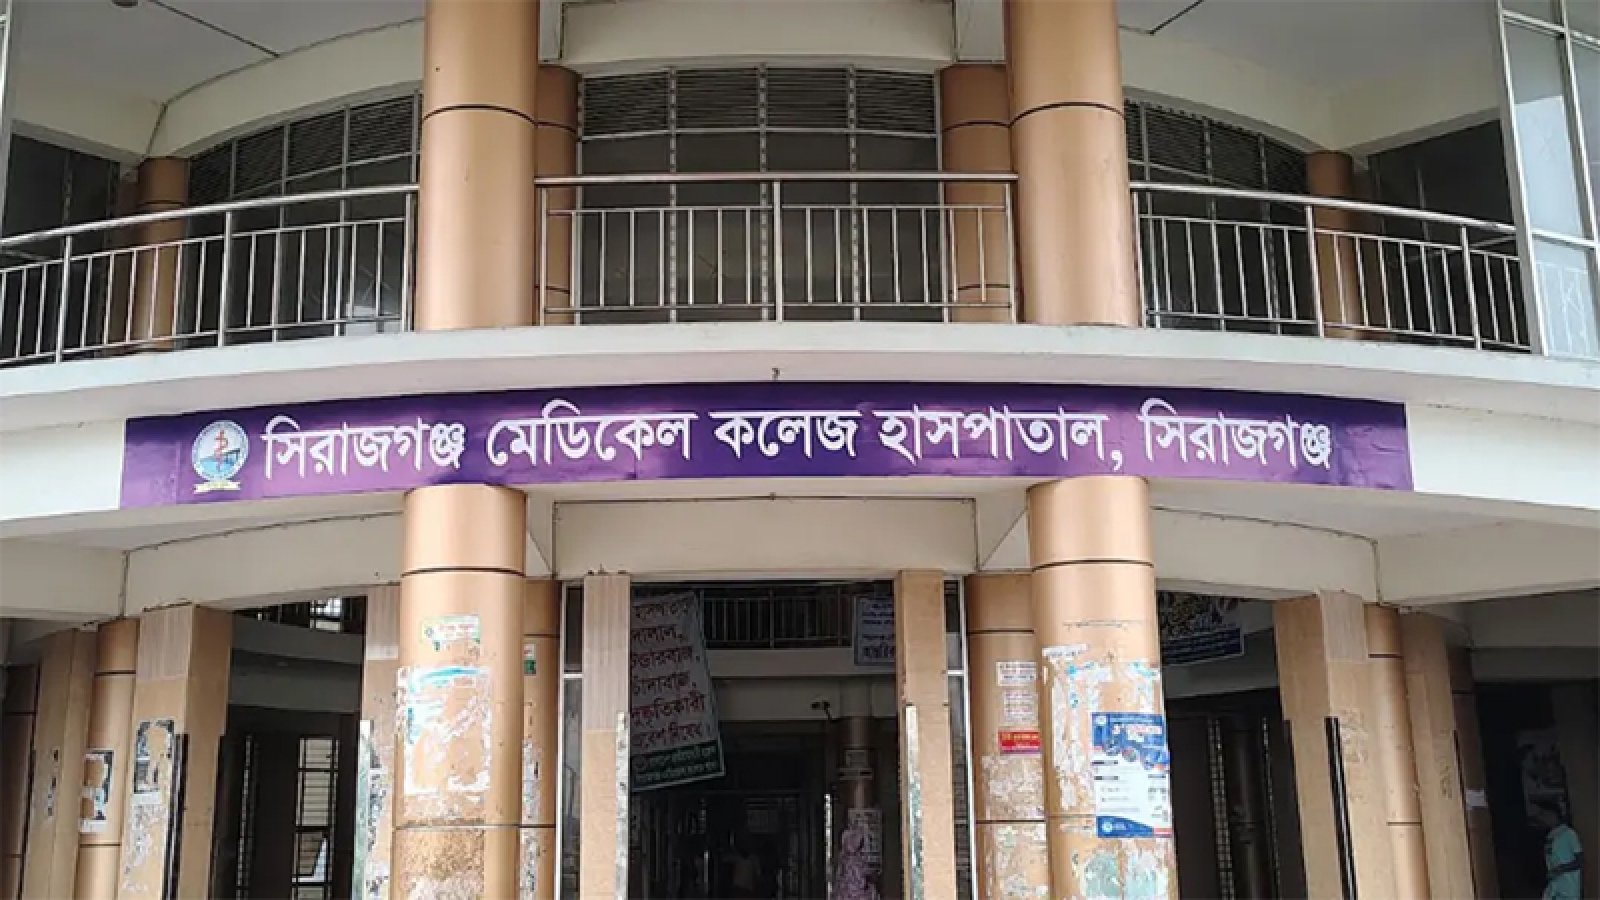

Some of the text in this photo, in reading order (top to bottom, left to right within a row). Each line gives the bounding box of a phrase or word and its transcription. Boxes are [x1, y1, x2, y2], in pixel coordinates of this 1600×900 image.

[260, 415, 466, 480] সিরাজগঞ্জ
[487, 399, 699, 466] মেডিকেল
[708, 410, 863, 459] কলেজ
[871, 404, 1124, 472] হাসপাতাল,
[1136, 397, 1332, 470] সিরাজগঞ্জ
